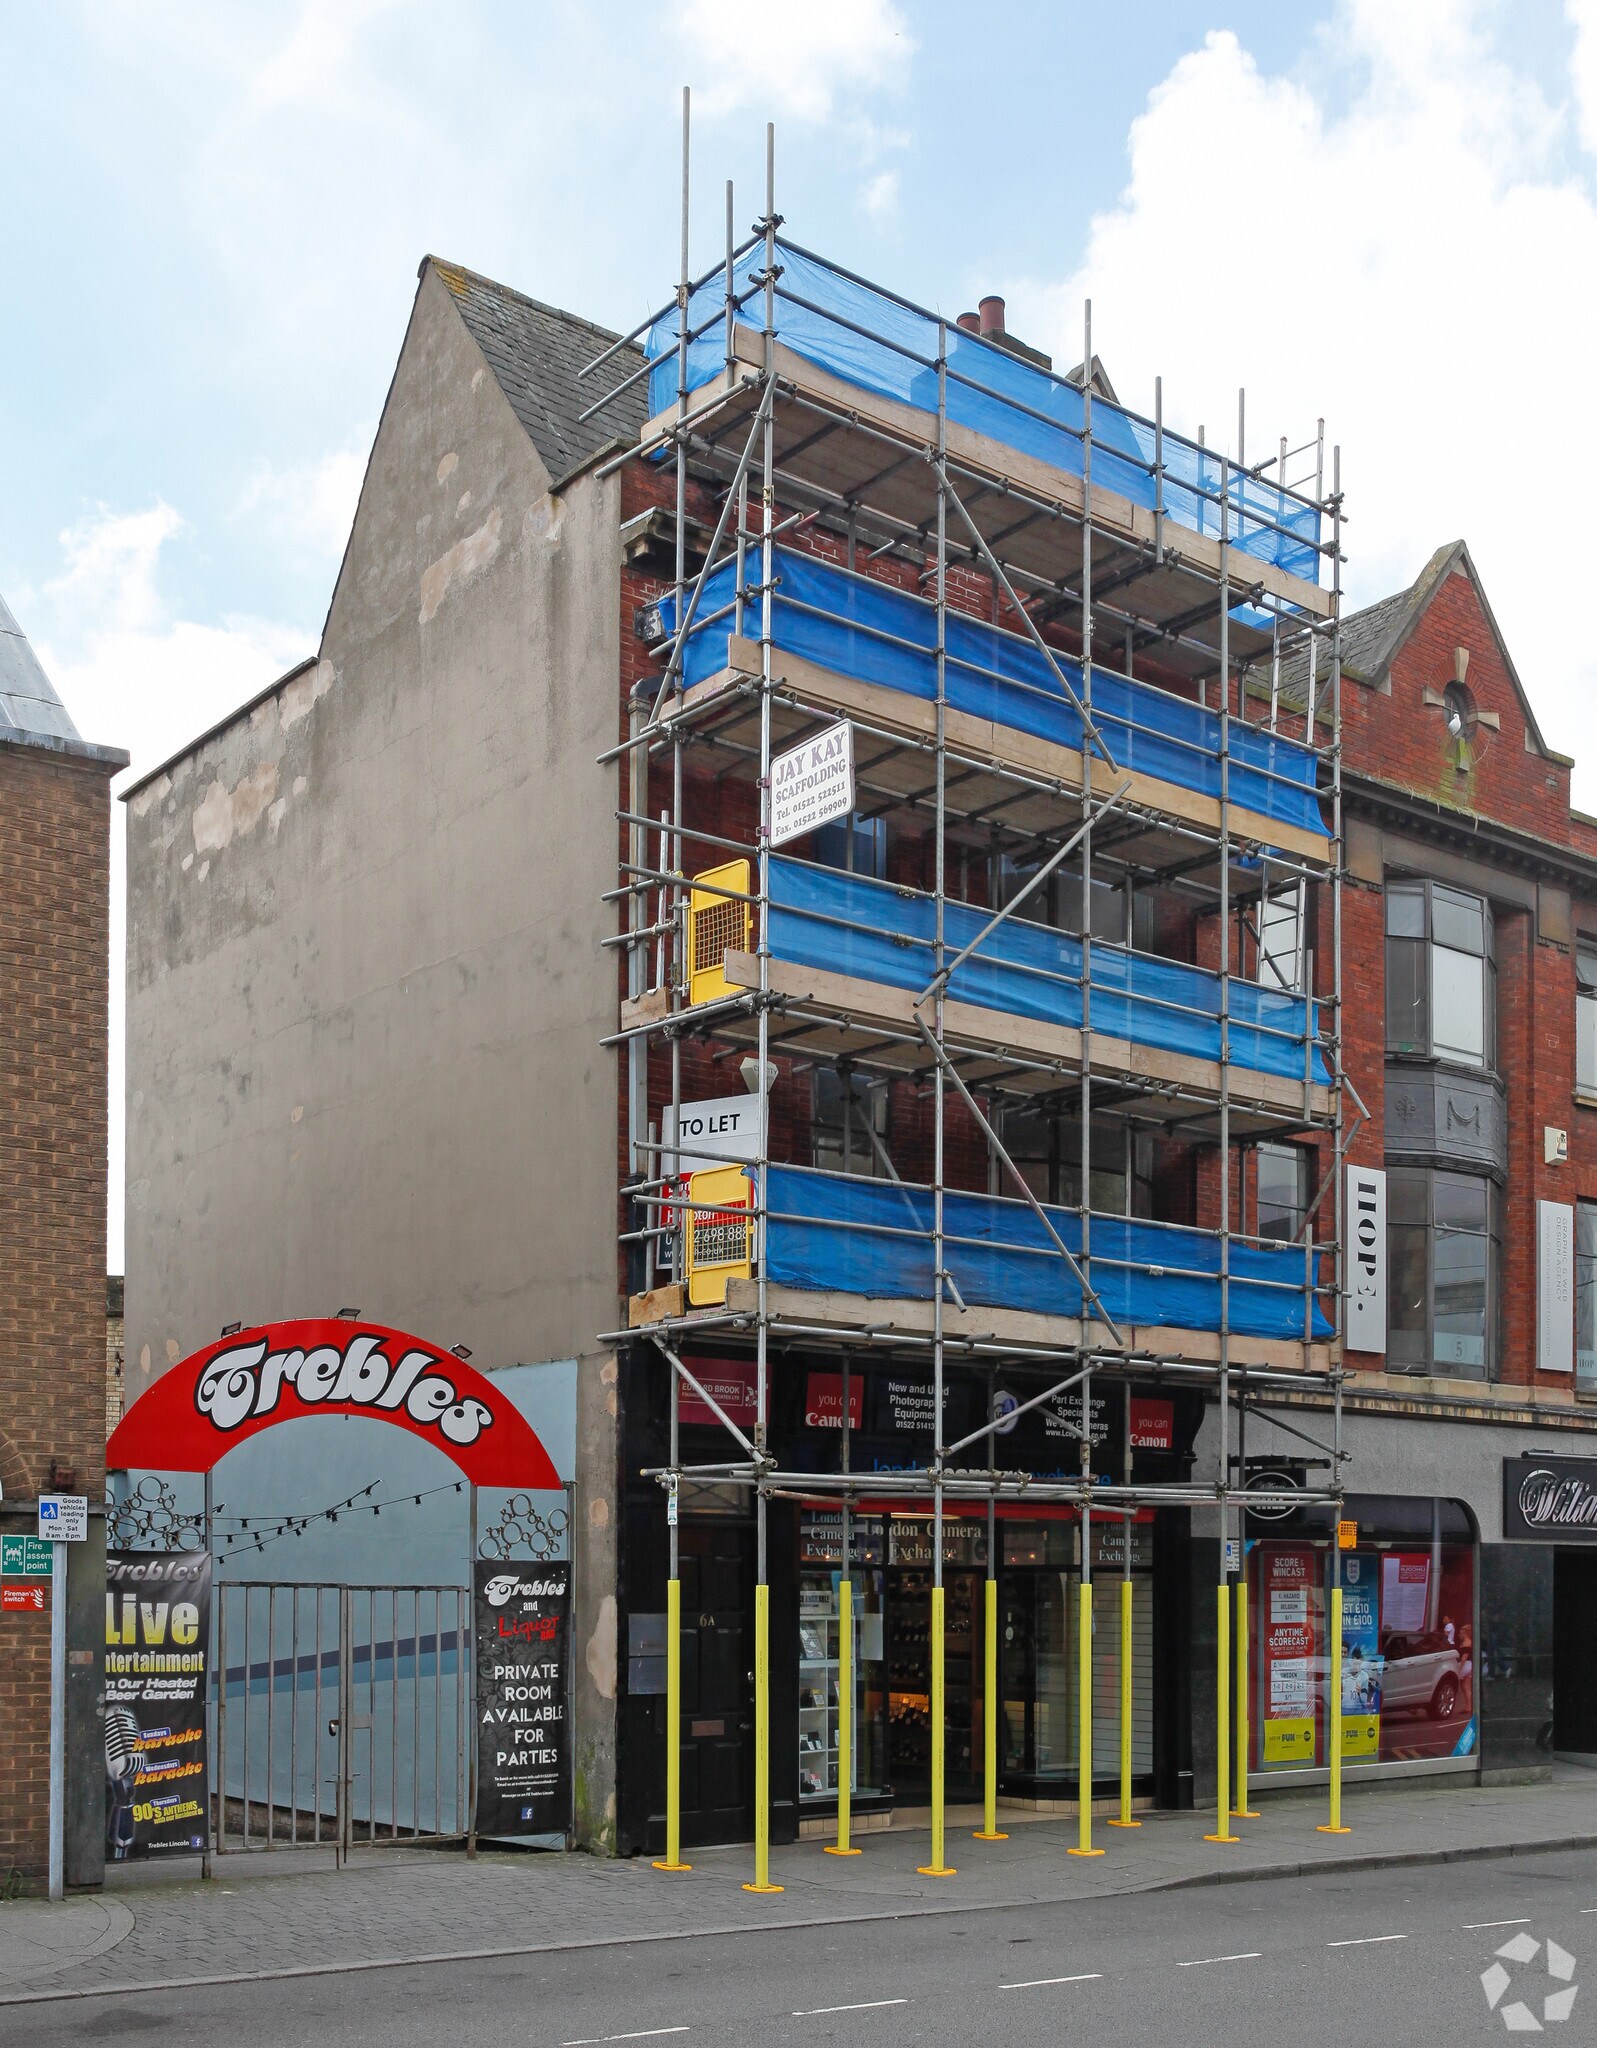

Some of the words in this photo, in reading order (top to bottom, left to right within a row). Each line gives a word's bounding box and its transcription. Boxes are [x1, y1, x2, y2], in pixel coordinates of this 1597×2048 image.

[776, 752, 806, 786] JAY
[811, 731, 846, 768] KAY
[775, 758, 846, 804] SCAFFOLDING
[776, 807, 791, 820] Tel.
[793, 796, 815, 812] 01522
[818, 781, 846, 802] 522511
[775, 825, 792, 837] Fax.
[794, 811, 816, 829] 01522
[819, 796, 847, 820] 569909
[680, 1119, 703, 1137] TO
[709, 1113, 741, 1133] LET
[196, 1334, 493, 1444] Trebles
[715, 1385, 740, 1394] BROOK
[888, 1382, 907, 1392] New
[909, 1385, 925, 1394] and
[818, 1395, 836, 1408] you
[839, 1397, 856, 1406] cn
[889, 1395, 947, 1408] Photograpc
[1051, 1395, 1067, 1404] Part
[896, 1420, 915, 1429] 01522
[1138, 1418, 1153, 1430] you
[1154, 1419, 1168, 1428] can
[1130, 1434, 1167, 1448] Canon
[810, 1526, 855, 1541] Camea
[1102, 1534, 1139, 1546] Camra
[28, 1541, 43, 1550] Fire
[889, 1542, 957, 1562] Exchage
[26, 1552, 53, 1560] assem
[1275, 1558, 1299, 1567] SCORE
[27, 1561, 48, 1570] point
[1272, 1568, 1306, 1577] WINCAST
[484, 1575, 566, 1606] Trebles
[523, 1600, 538, 1611] and
[1343, 1603, 1353, 1613] ET
[1355, 1603, 1369, 1613] £10
[105, 1592, 199, 1645] Live
[700, 1614, 715, 1627] 6A
[1343, 1615, 1351, 1625] IN
[1354, 1615, 1372, 1625] £100
[498, 1615, 560, 1642] Liquor
[1274, 1628, 1304, 1637] ANYTIME
[1269, 1637, 1309, 1646] SCORECAST
[105, 1651, 204, 1673] ntertainment
[494, 1663, 559, 1680] PRIVATE
[117, 1678, 143, 1689] Our
[146, 1677, 198, 1688] Heated
[105, 1690, 139, 1701] Beer
[142, 1689, 195, 1700] Garden
[505, 1685, 551, 1701] ROOM
[482, 1705, 563, 1724] AVAILABLE
[132, 1728, 203, 1752] karaoke
[143, 1730, 167, 1739] Sundays
[514, 1728, 544, 1744] FOR
[497, 1749, 558, 1766] PARTIES
[145, 1762, 178, 1772] Wednesdays
[133, 1762, 203, 1786] karaoke
[153, 1797, 178, 1806] Thursdays
[163, 1801, 198, 1816] ANTHEMS
[169, 1840, 190, 1848] Lincoln
